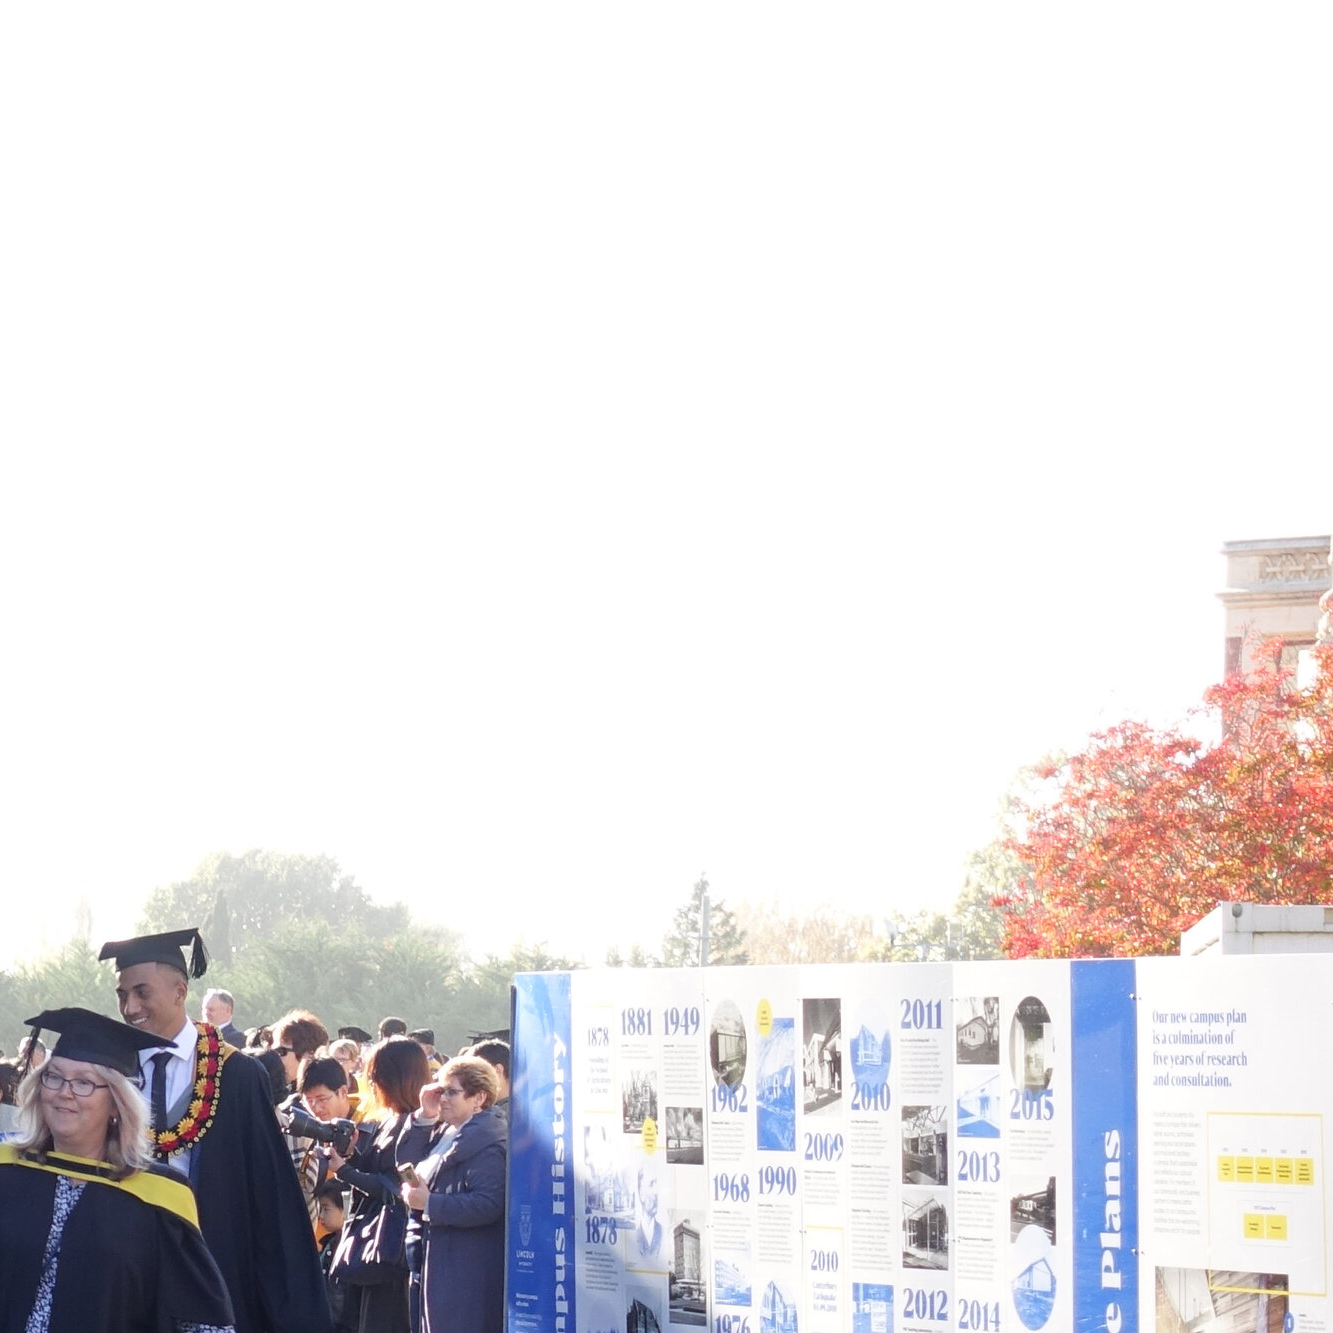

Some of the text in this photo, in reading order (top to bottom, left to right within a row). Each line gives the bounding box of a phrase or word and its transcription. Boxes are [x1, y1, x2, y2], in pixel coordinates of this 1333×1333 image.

[621, 1007, 653, 1036] 1881
[663, 1006, 700, 1036] 1949
[900, 998, 943, 1030] 2011
[1152, 1008, 1247, 1027] Our new campus plan
[587, 1027, 610, 1047] 1878
[1152, 1028, 1236, 1045] is a culmination of
[1152, 1050, 1248, 1069] five years of research
[1152, 1071, 1232, 1088] and consultation.
[711, 1083, 748, 1113] 1962
[850, 1081, 891, 1111] 2010
[1010, 1087, 1055, 1121] 2015
[551, 1032, 567, 1215] History
[804, 1132, 844, 1162] 2009
[758, 1165, 797, 1196] 1990
[957, 1150, 1001, 1183] 2013
[713, 1172, 750, 1203] 1968
[1099, 1129, 1121, 1291] Plans
[585, 1215, 618, 1245] 1878
[810, 1249, 839, 1273] 2010
[902, 1287, 949, 1322] 2012
[958, 1298, 1001, 1333] 2014
